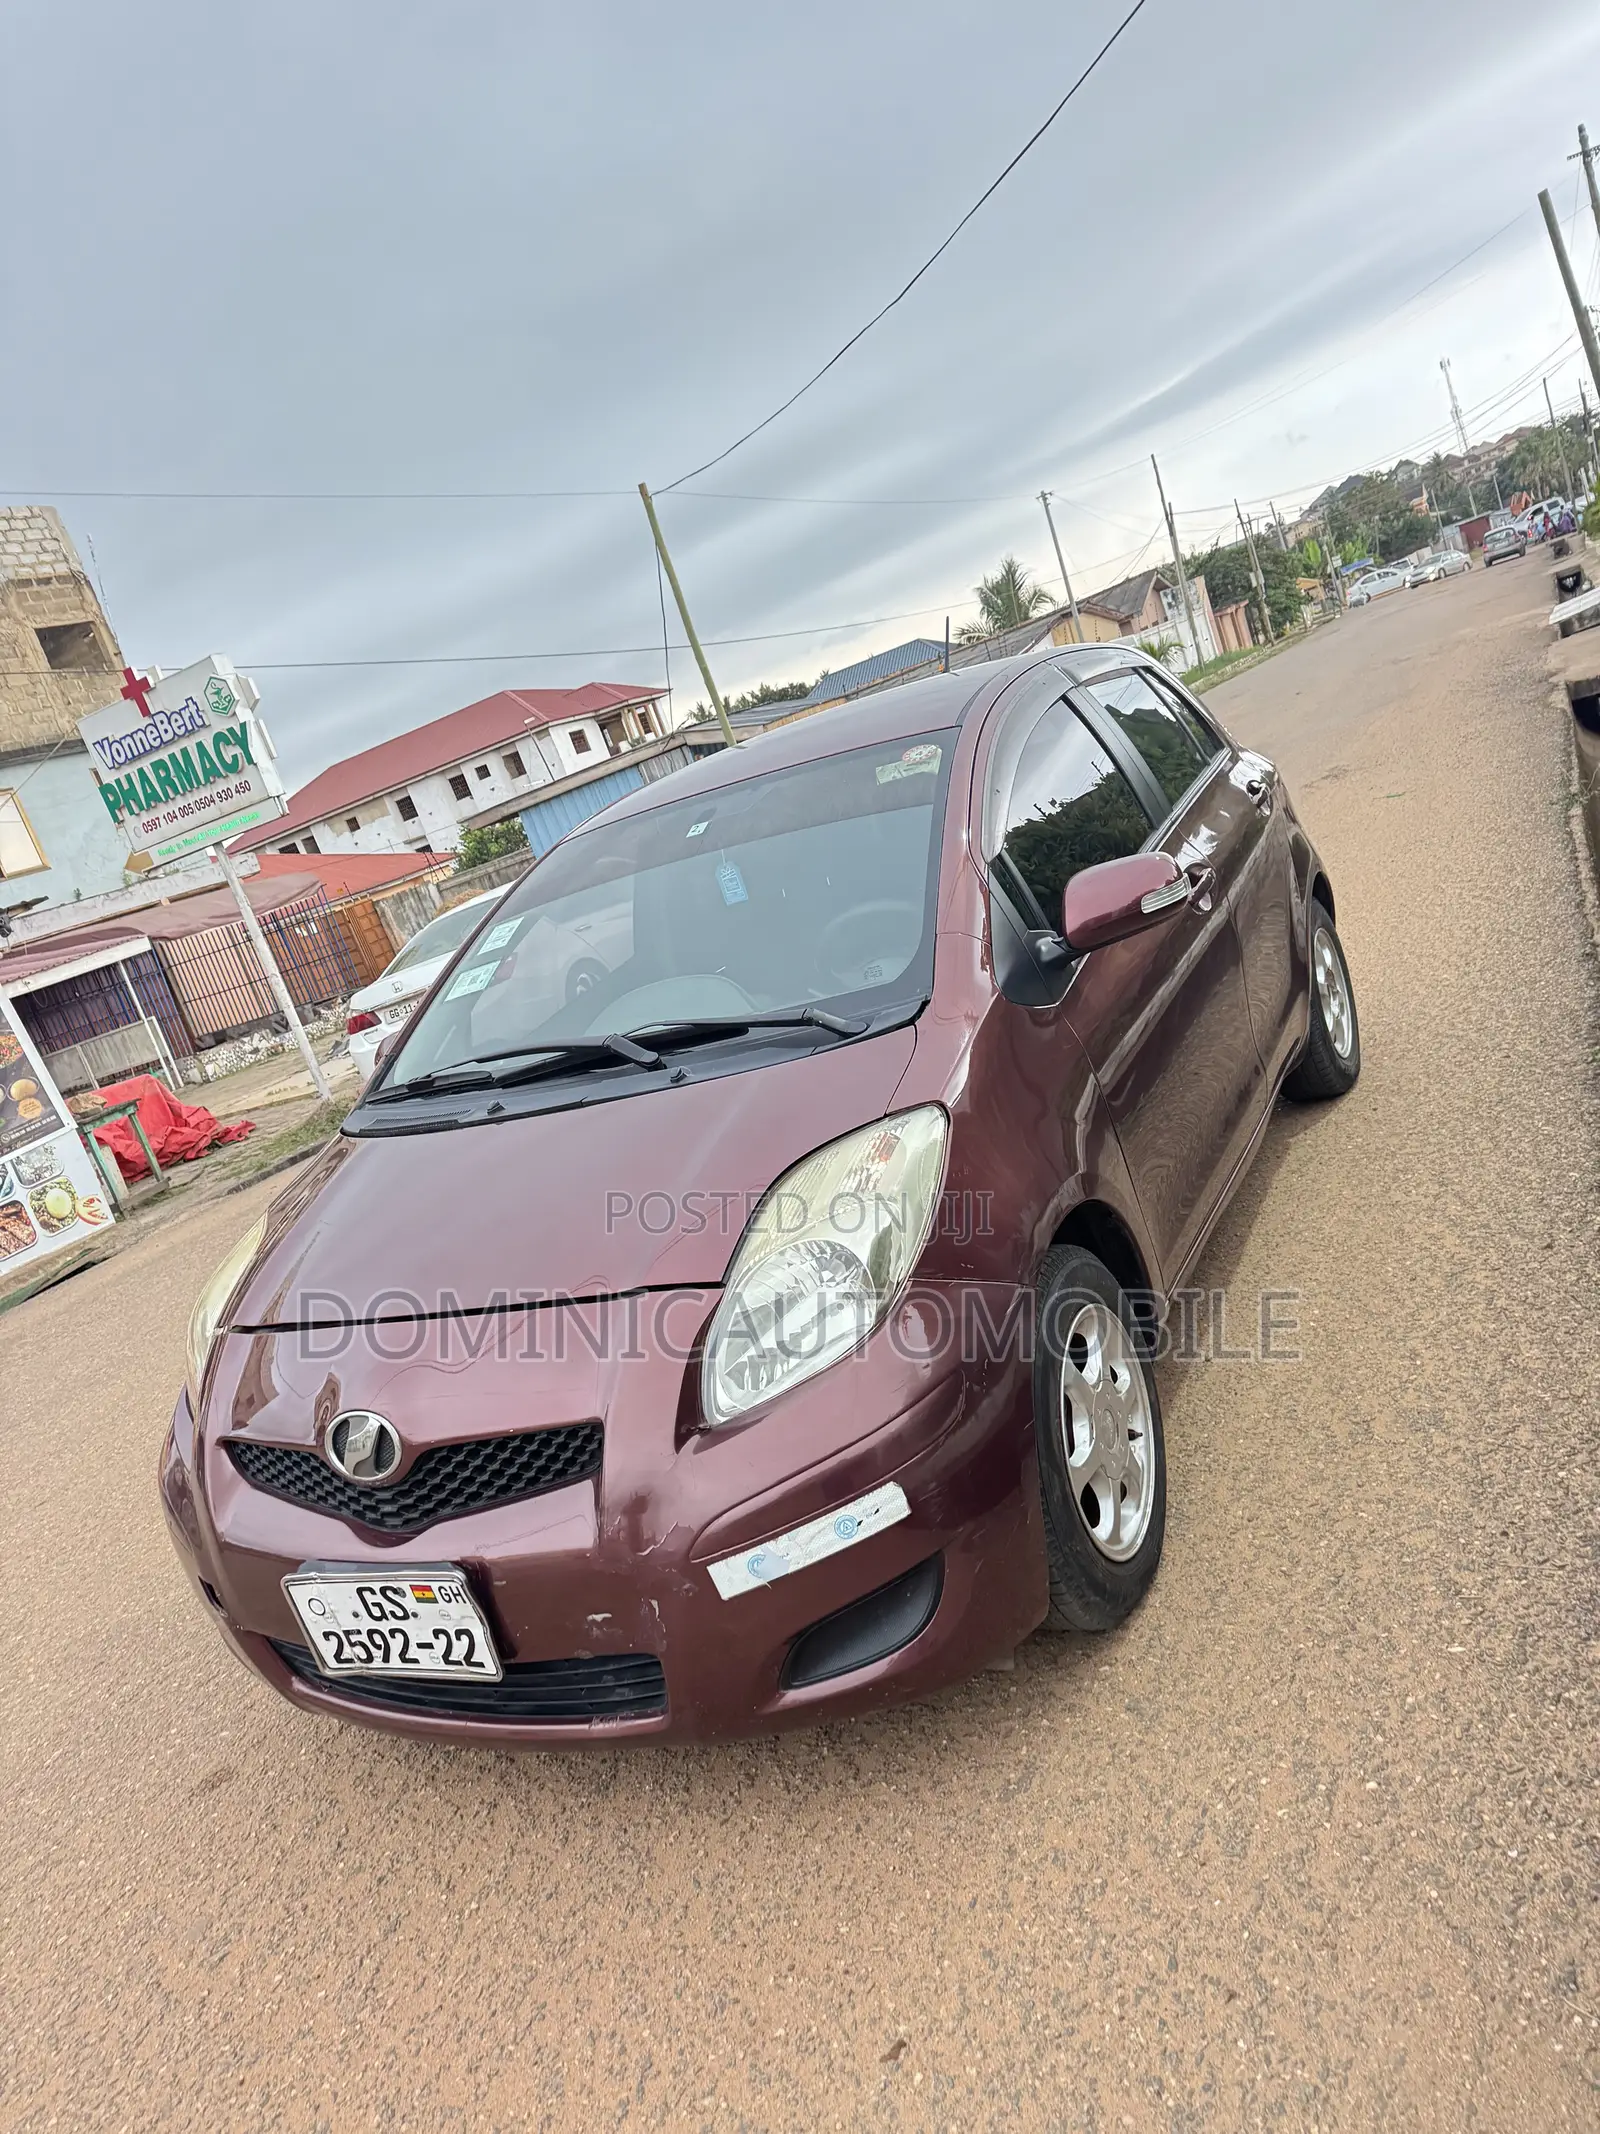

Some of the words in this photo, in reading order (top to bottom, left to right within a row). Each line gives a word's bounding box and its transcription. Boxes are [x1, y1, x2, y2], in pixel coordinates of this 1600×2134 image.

[93, 697, 206, 770] VonneBert
[99, 721, 256, 824] PHARMACY
[142, 816, 162, 834] 0597
[163, 808, 179, 826] 104
[216, 786, 234, 803] 930
[234, 779, 252, 796] 450
[356, 1586, 410, 1622] GS
[438, 1586, 467, 1604] GH
[322, 1627, 486, 1668] 2592-22
